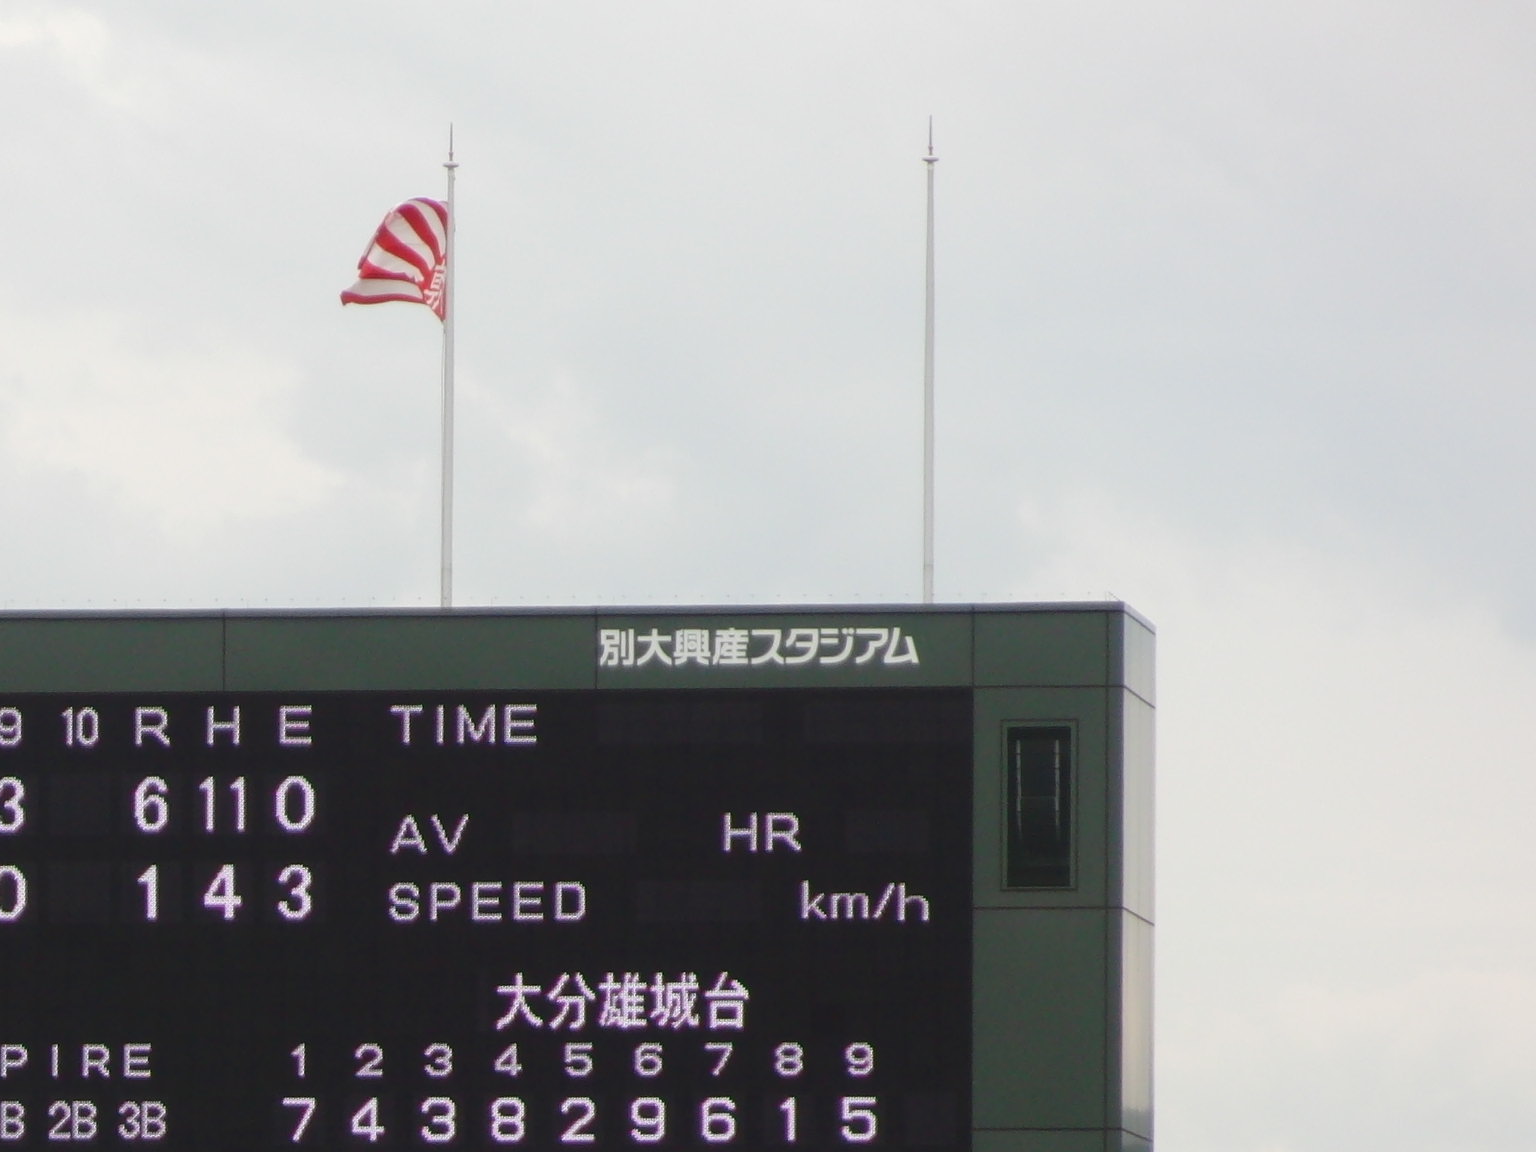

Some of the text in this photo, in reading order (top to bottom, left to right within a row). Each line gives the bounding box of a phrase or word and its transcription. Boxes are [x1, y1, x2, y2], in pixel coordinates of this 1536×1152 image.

[599, 627, 920, 667] 別大興産スタジアム
[62, 706, 99, 746] 10
[135, 706, 170, 745] R
[207, 705, 240, 745] H
[279, 704, 312, 745] E
[390, 704, 537, 744] TIME
[134, 776, 168, 832] 6
[199, 776, 245, 831] 11
[275, 775, 315, 831] 0
[391, 813, 469, 853] AV
[724, 812, 802, 851] HR
[137, 864, 157, 919] 1
[203, 864, 242, 919] 4
[277, 864, 312, 919] 3
[389, 881, 586, 921] SPEED
[802, 880, 930, 921] km/h
[496, 971, 749, 1030] 大分雄城台
[292, 1042, 874, 1077] 1 2 3 4 5 6 7 8 9
[48, 1100, 97, 1140] 2B
[118, 1100, 167, 1139] 3B
[282, 1096, 877, 1142] 7 4 3 8 2 9 6 1 5
